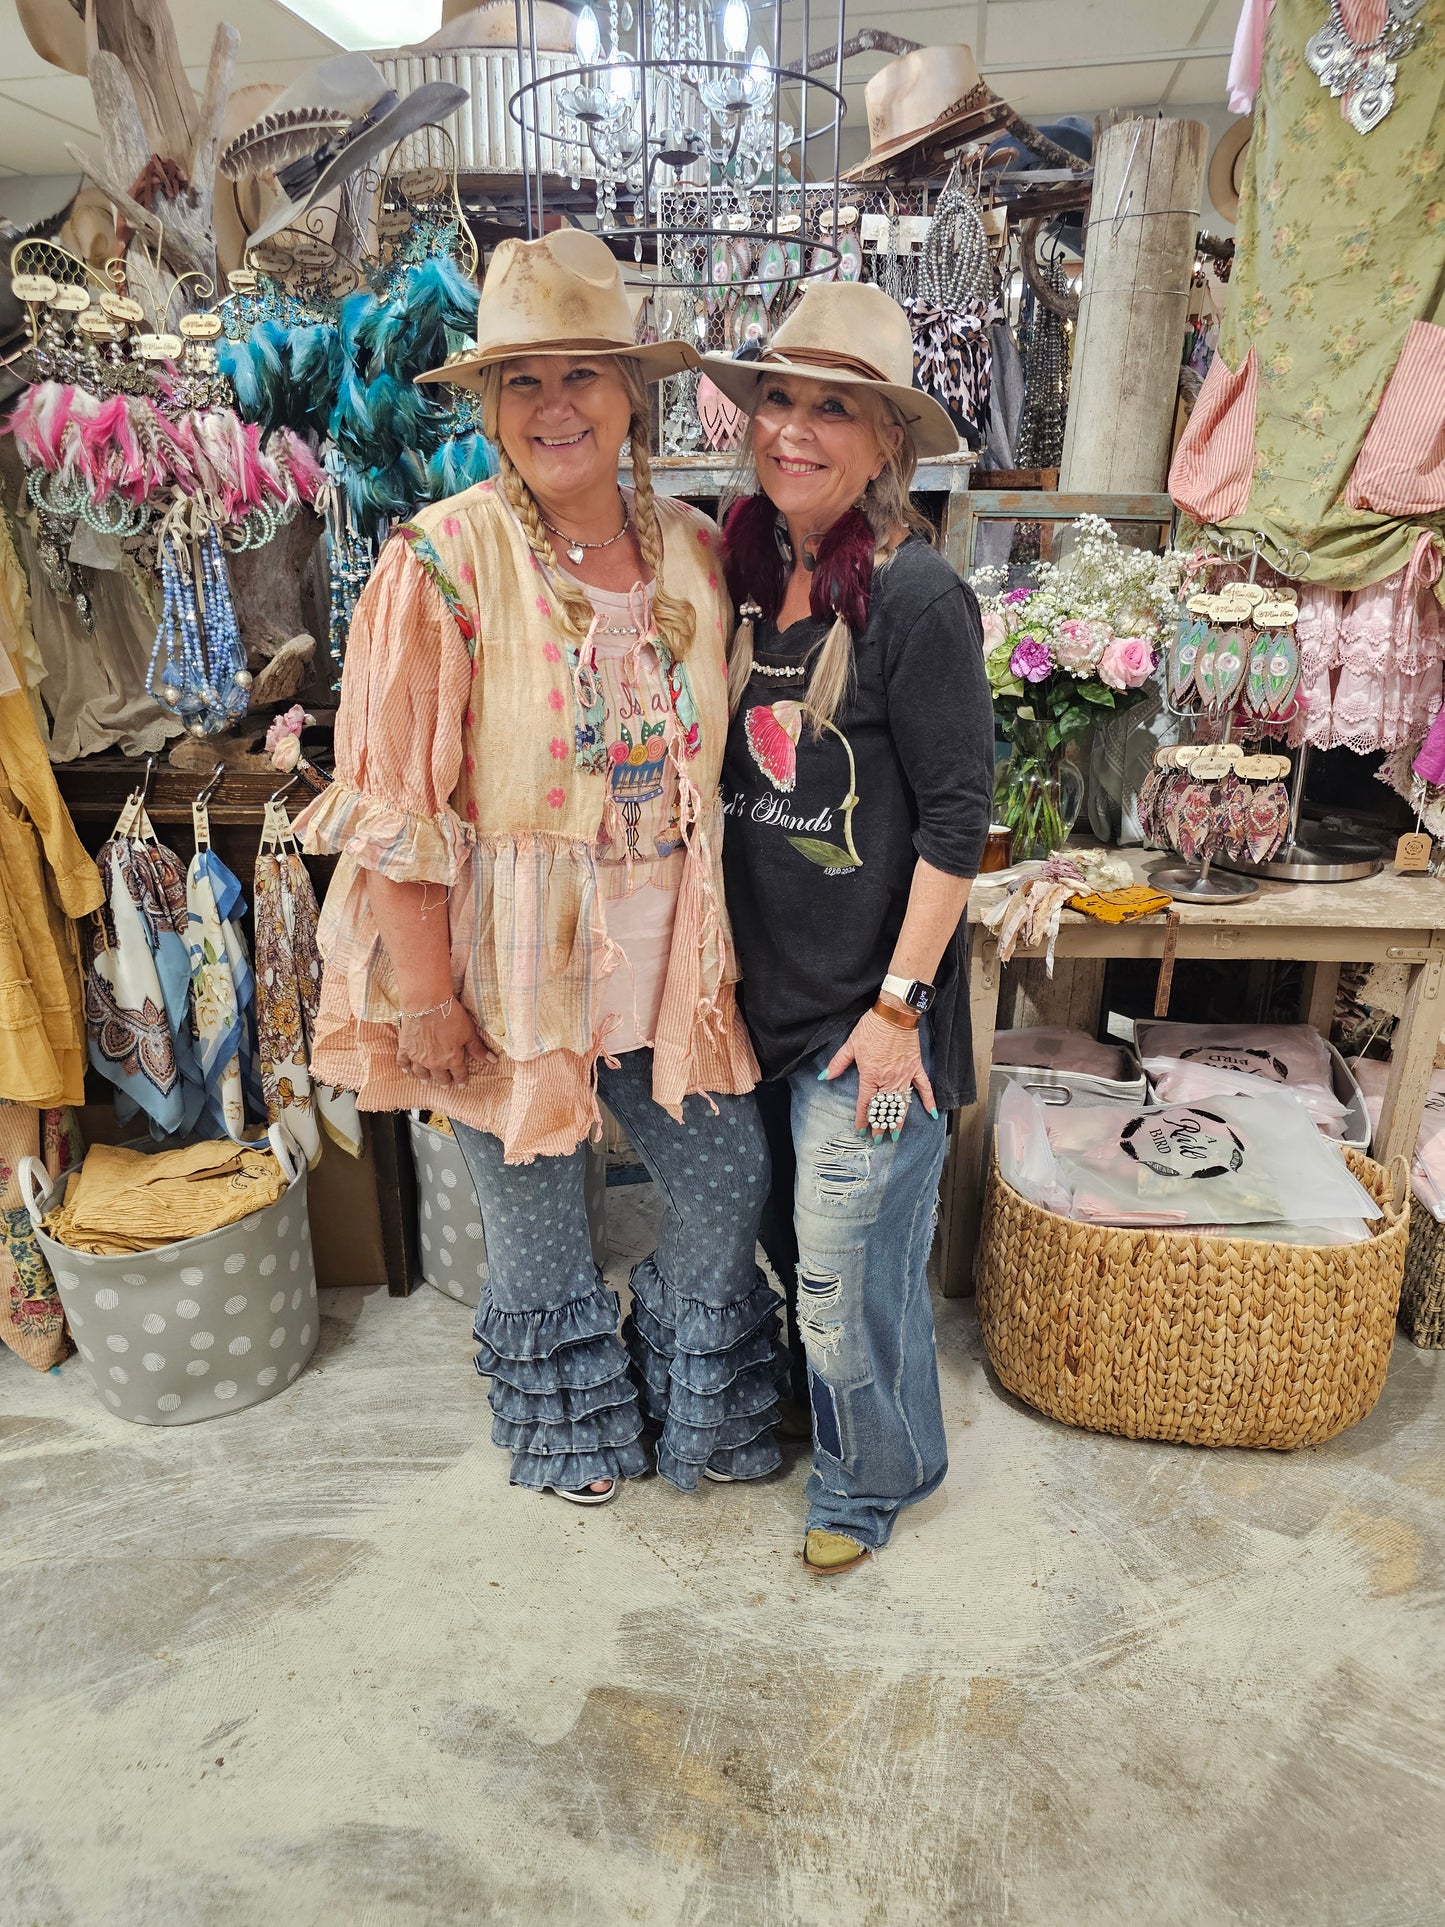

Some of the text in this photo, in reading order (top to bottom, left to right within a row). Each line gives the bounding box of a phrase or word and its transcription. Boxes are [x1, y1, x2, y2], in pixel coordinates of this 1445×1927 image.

[751, 791, 833, 832] Hands
[1209, 1053, 1249, 1067] BIRD
[1150, 1128, 1171, 1154] BIRD
